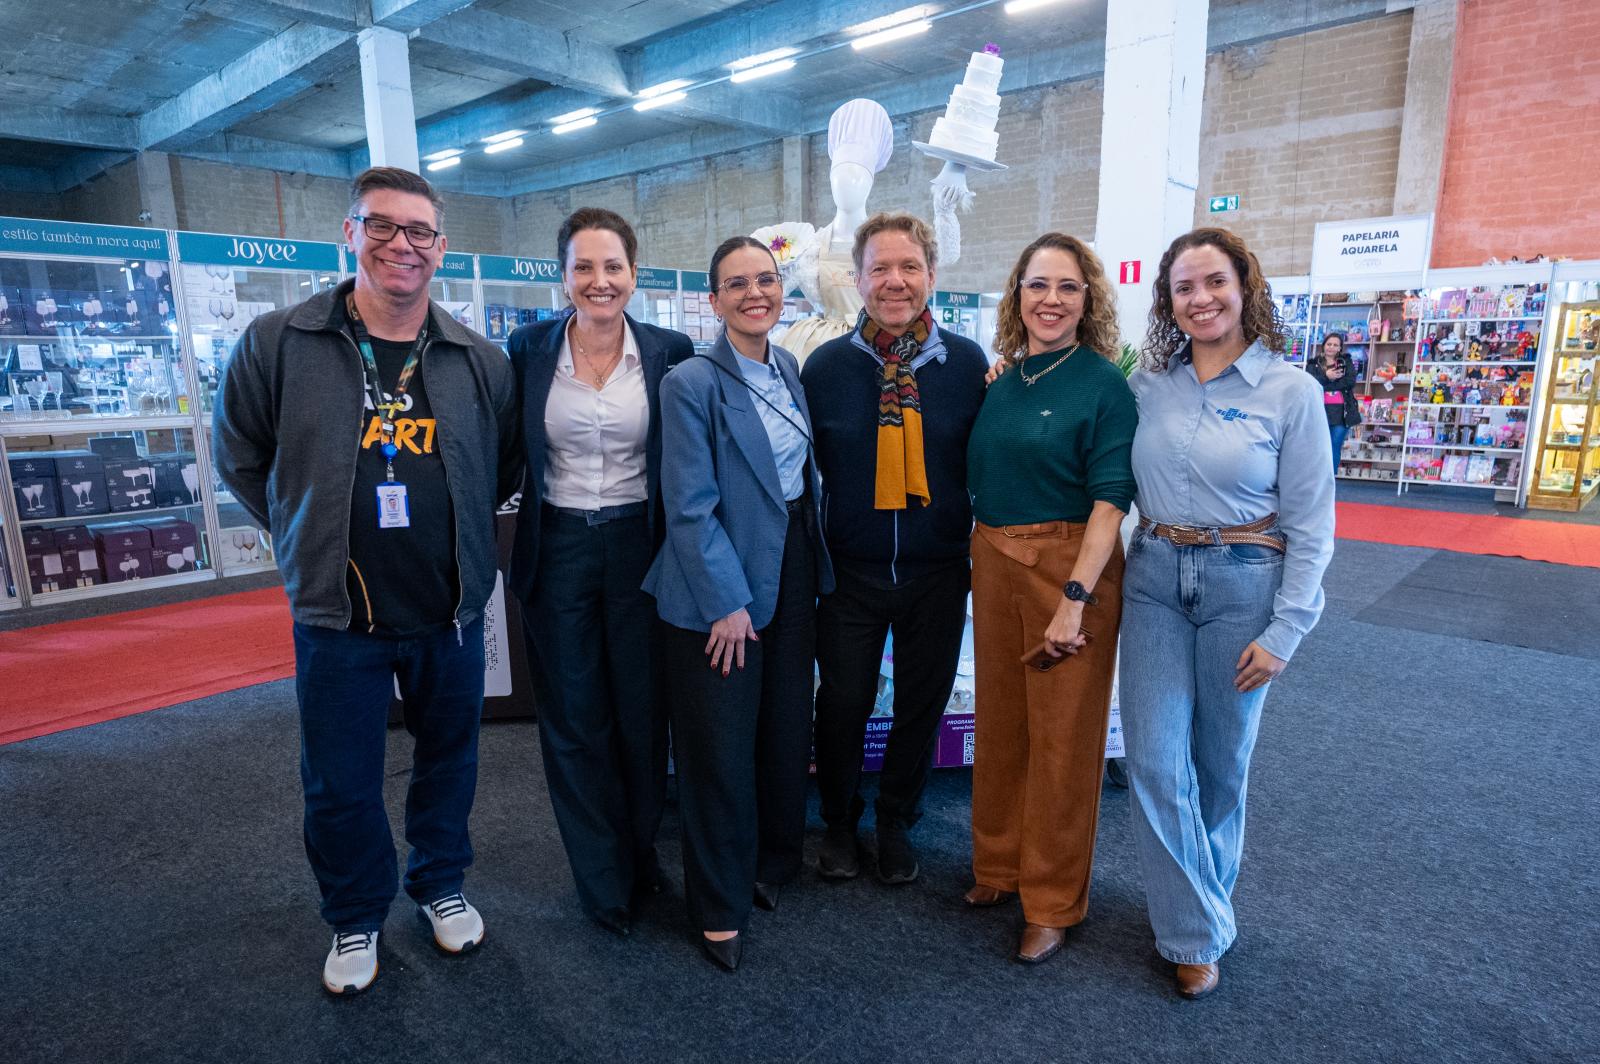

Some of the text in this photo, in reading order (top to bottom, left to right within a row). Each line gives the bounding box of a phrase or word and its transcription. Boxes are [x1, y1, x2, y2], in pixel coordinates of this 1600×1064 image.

[2, 228, 161, 251] estilo também mora aqui!
[1342, 230, 1400, 243] PAPELARIA
[227, 238, 297, 264] Joyee
[1341, 243, 1398, 256] AQUARELA
[445, 261, 465, 270] casa!
[511, 259, 557, 280] Joyee
